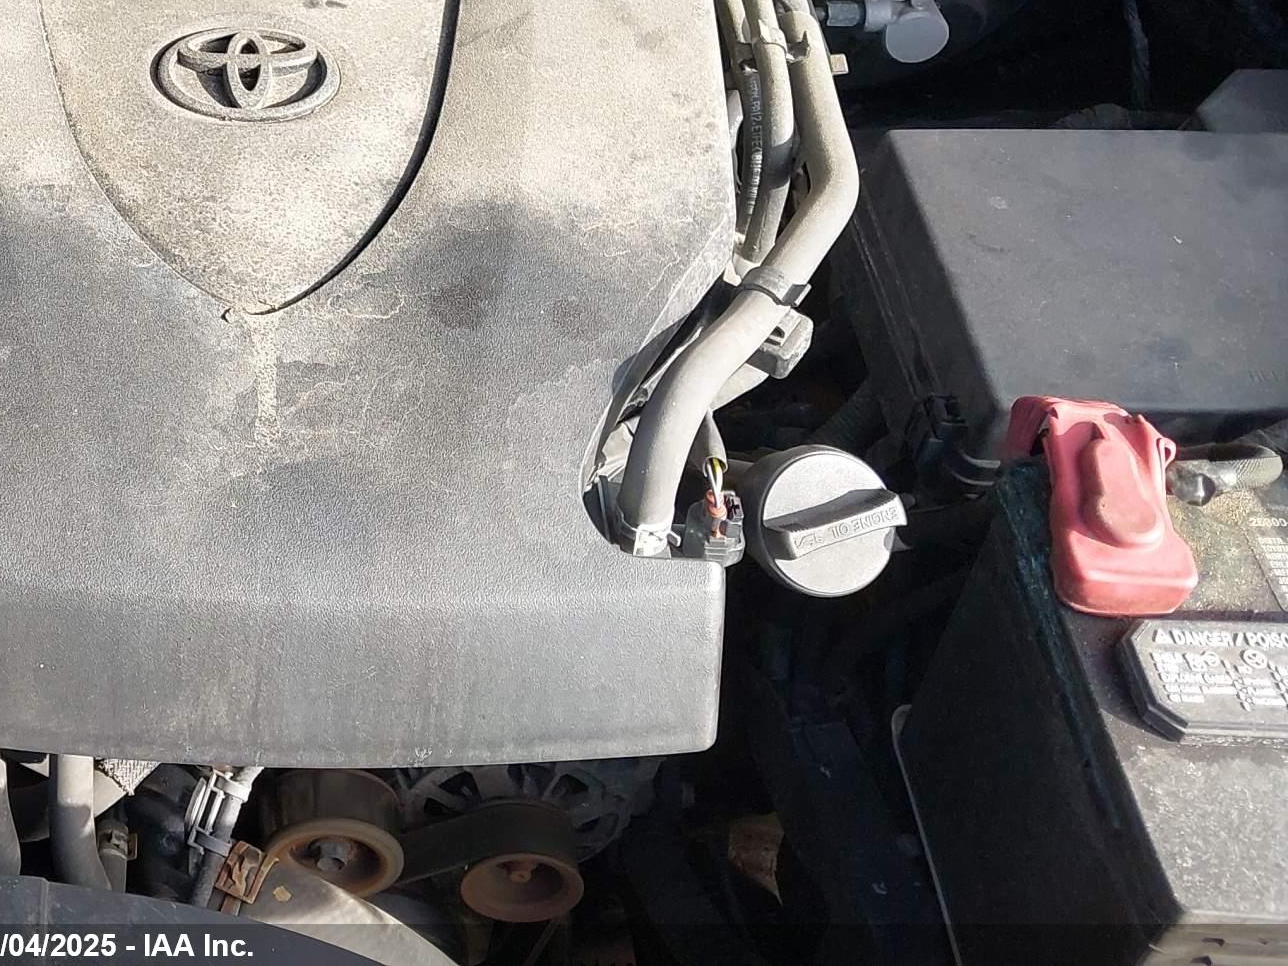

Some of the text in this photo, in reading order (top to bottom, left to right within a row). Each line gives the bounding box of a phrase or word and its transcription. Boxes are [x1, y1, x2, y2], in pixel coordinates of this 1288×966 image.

[828, 506, 899, 539] ENGINE OIL
[1171, 629, 1234, 647] DANGER
